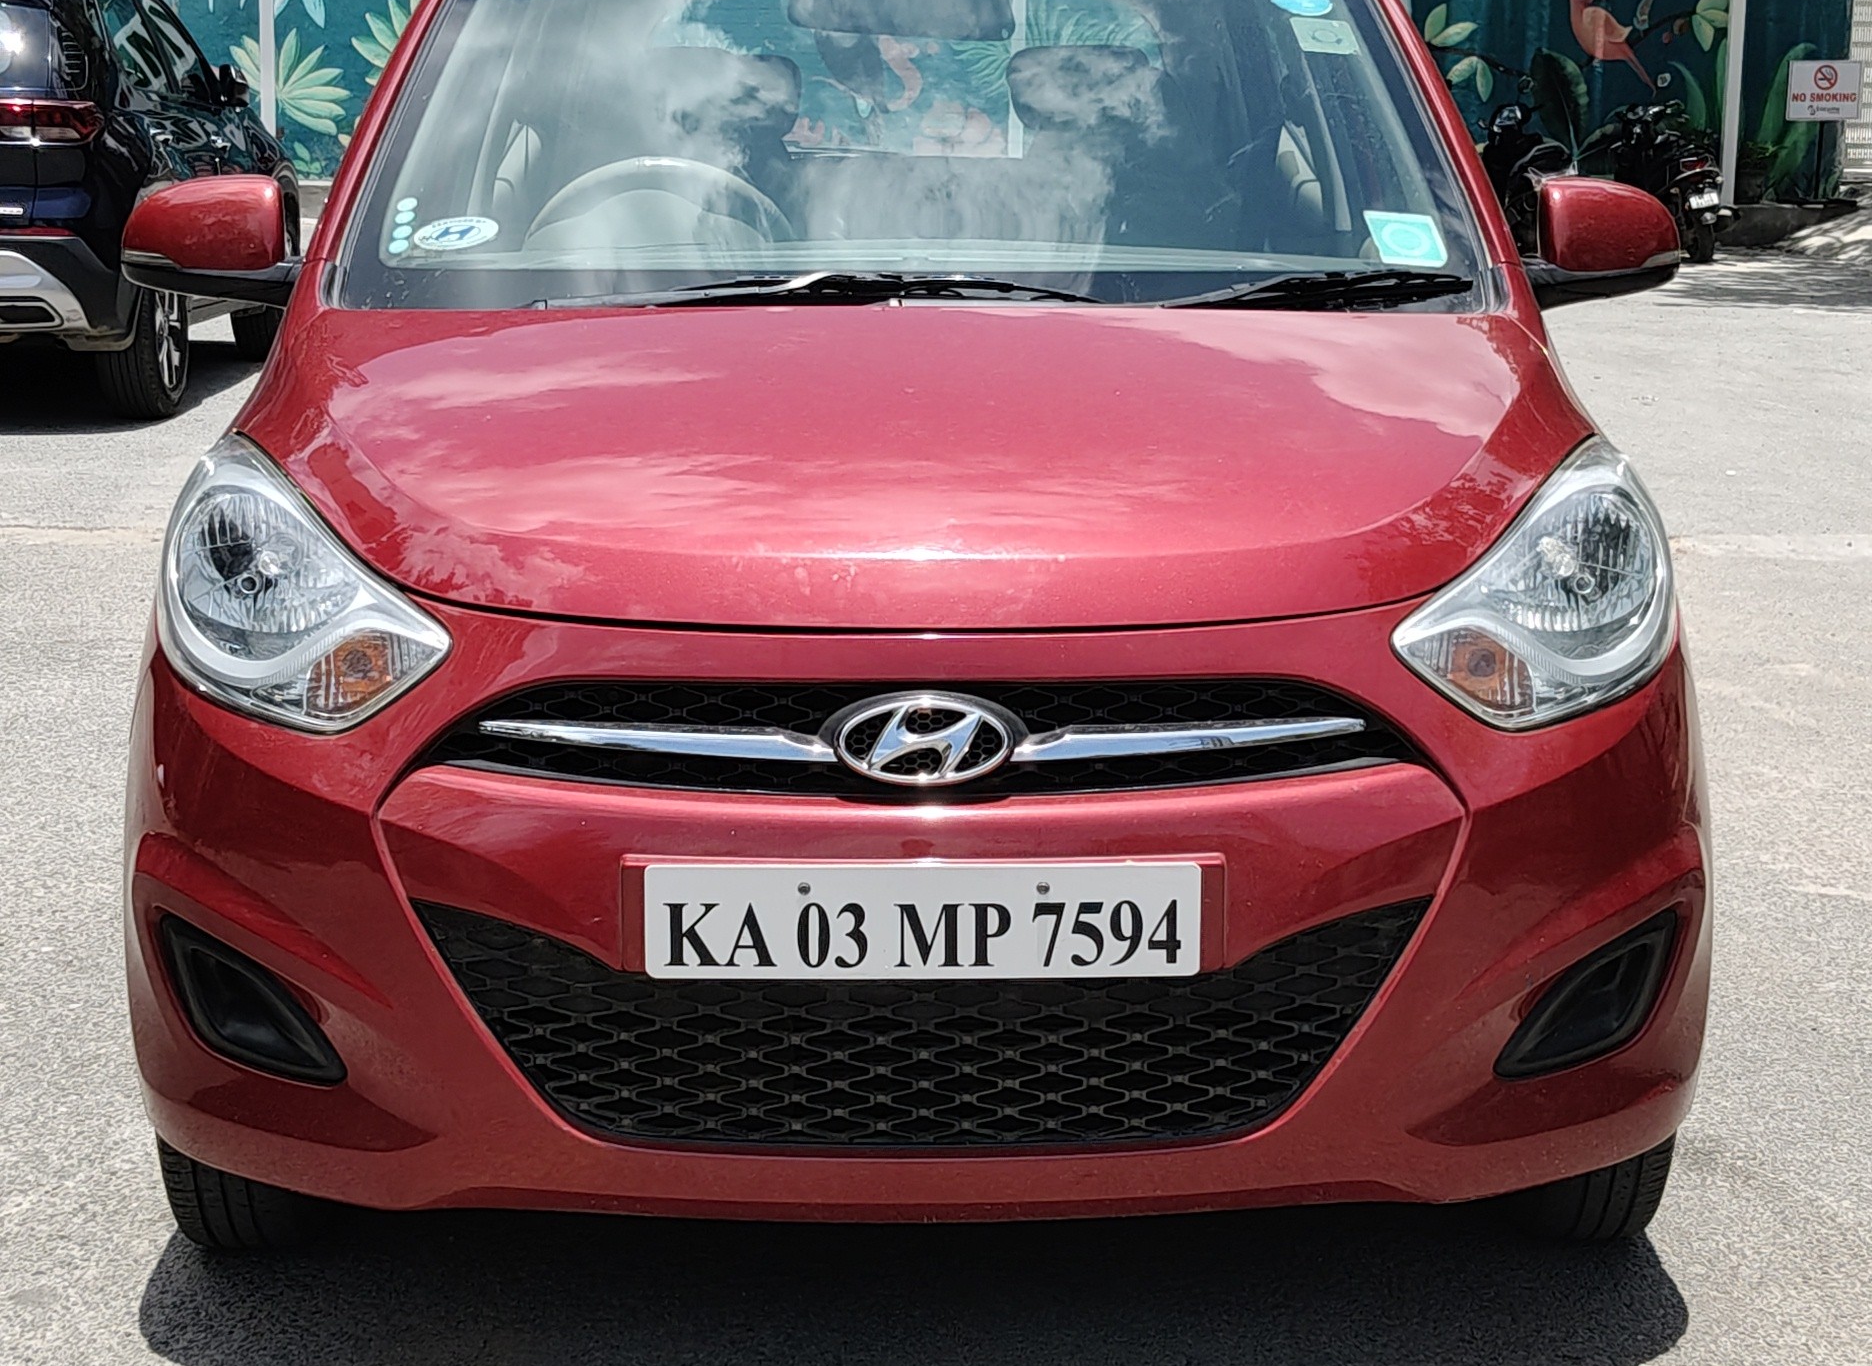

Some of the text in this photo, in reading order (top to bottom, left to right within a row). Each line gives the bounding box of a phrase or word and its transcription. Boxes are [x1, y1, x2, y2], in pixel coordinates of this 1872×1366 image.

[1791, 92, 1857, 103] NO SMOKING
[662, 898, 1182, 969] KA 03 MP 7594
